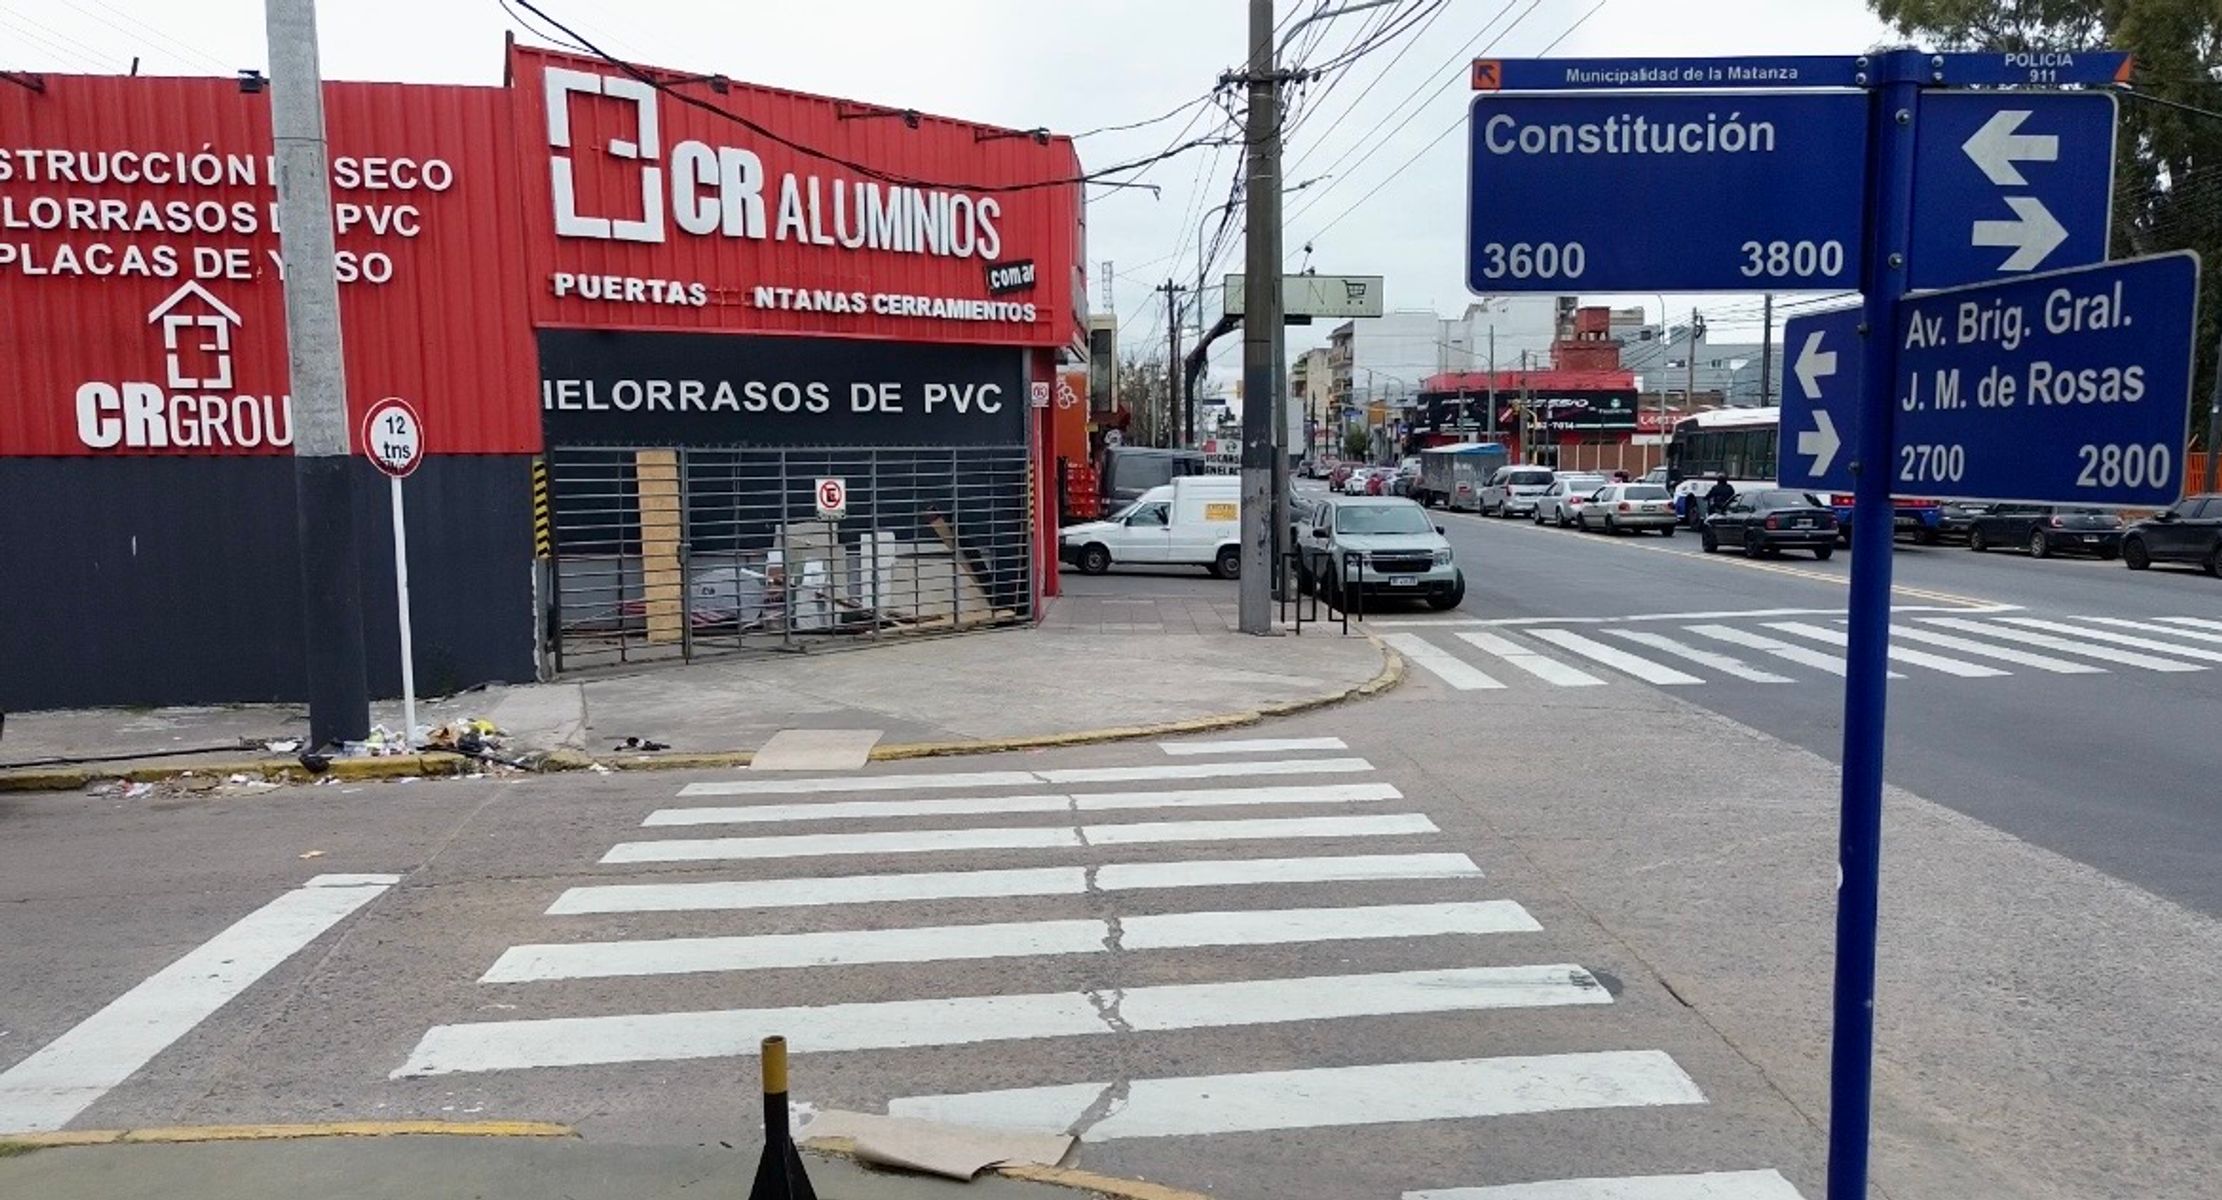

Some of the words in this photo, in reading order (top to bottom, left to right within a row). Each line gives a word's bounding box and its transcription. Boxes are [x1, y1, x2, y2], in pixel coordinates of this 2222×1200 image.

[1566, 67, 1678, 85] Municipalidad
[1683, 67, 1703, 81] de
[1709, 66, 1722, 80] la
[1728, 65, 1798, 80] Matanza
[2005, 52, 2073, 67] POLICIA
[2030, 69, 2056, 83] 911
[1484, 112, 1774, 155] Constitución
[334, 156, 452, 191] SECO
[671, 141, 766, 239] CR
[776, 172, 1001, 260] ALUMINIOS
[336, 203, 420, 237] PVC
[0, 242, 178, 277] PLACAS
[194, 247, 252, 279] DE
[268, 250, 392, 283] YSO
[1483, 242, 1585, 279] 3600
[1740, 241, 1844, 277] 3800
[554, 272, 708, 307] PUERTAS
[755, 286, 867, 313] NTANAS
[873, 294, 1036, 322] CERRAMIENTOS
[1905, 309, 1946, 349] Av.
[1957, 298, 2031, 350] Brig.
[2045, 280, 2131, 334] Gral.
[543, 379, 830, 413] IELORRASOS
[850, 382, 903, 413] DE
[924, 383, 1002, 413] PVC
[1902, 372, 1925, 411] J.
[1935, 368, 1966, 410] M.
[1977, 365, 2016, 407] de
[2028, 361, 2145, 405] Rosas
[76, 382, 294, 447] CRGROU
[386, 416, 406, 434] 12
[384, 442, 411, 459] tns
[1900, 444, 1965, 482] 2700
[2076, 443, 2170, 489] 2800
